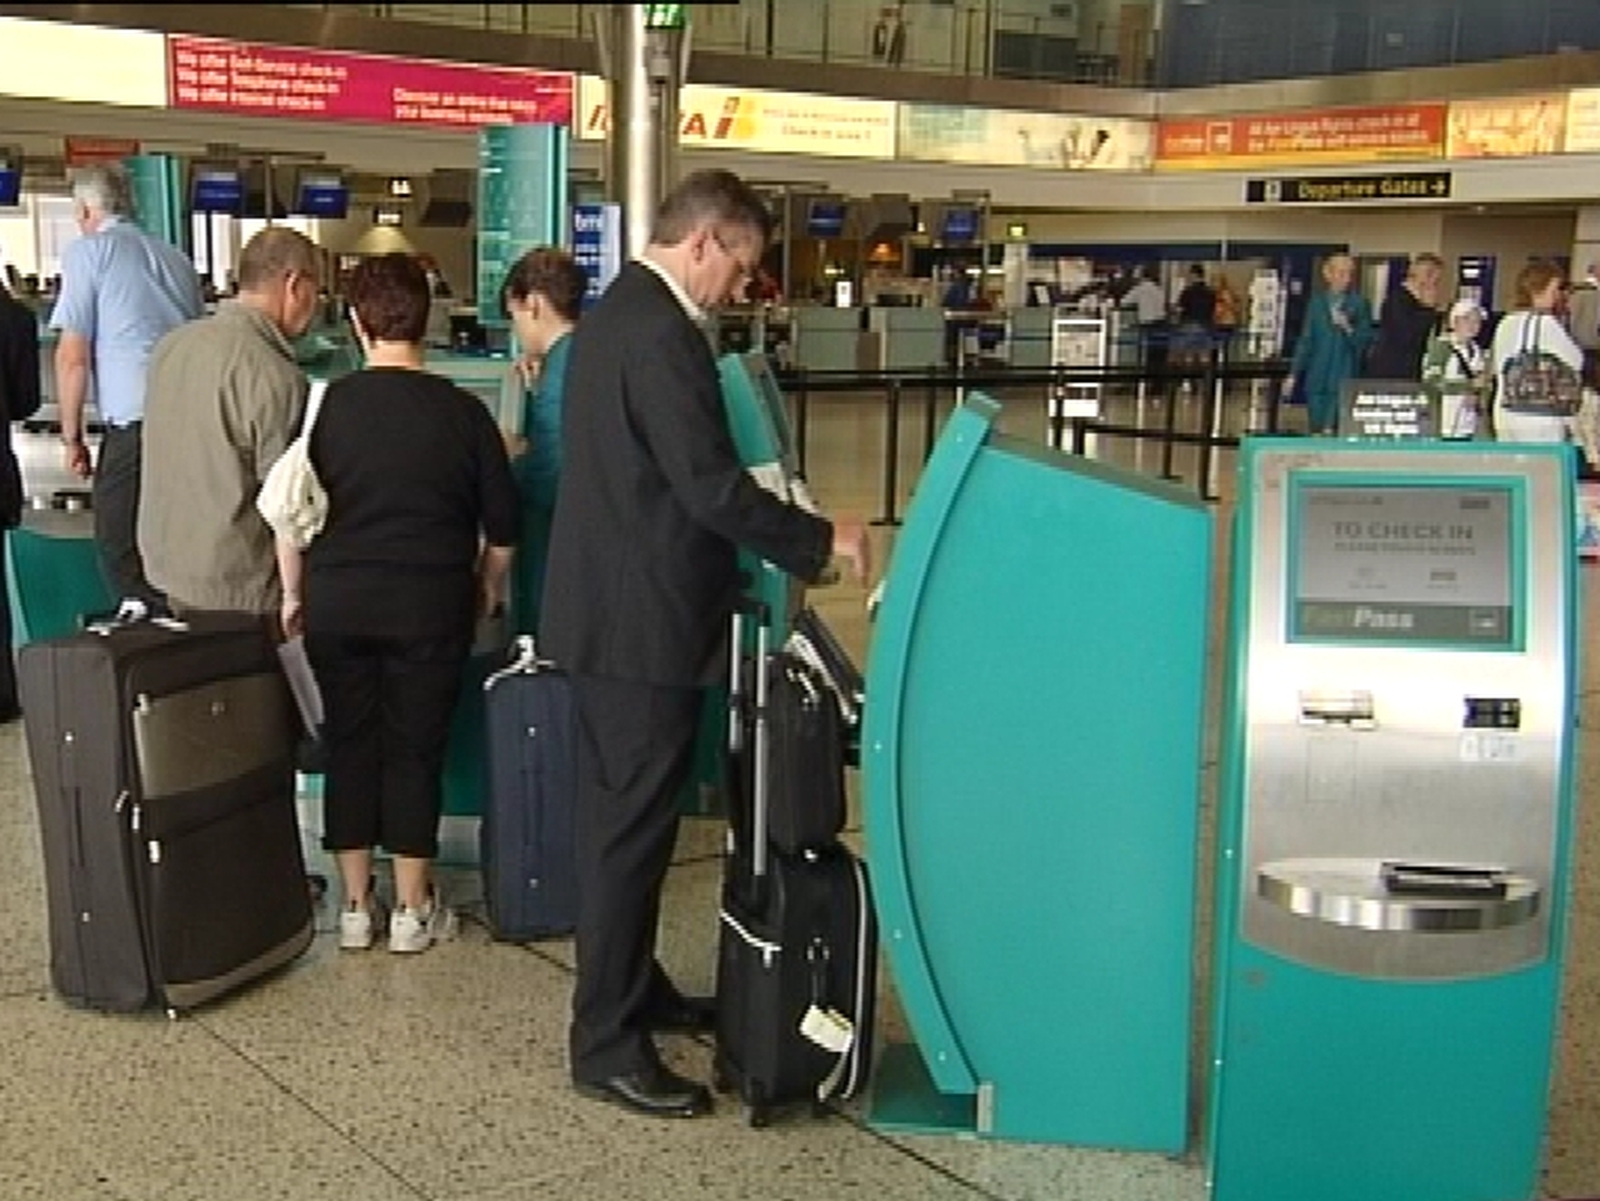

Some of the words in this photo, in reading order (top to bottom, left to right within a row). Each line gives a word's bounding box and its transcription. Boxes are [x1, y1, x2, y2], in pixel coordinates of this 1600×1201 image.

[1299, 180, 1376, 200] Departure
[1379, 178, 1428, 196] Gates
[1332, 521, 1363, 537] TO
[1367, 521, 1444, 540] CHECK
[1449, 524, 1474, 541] IN
